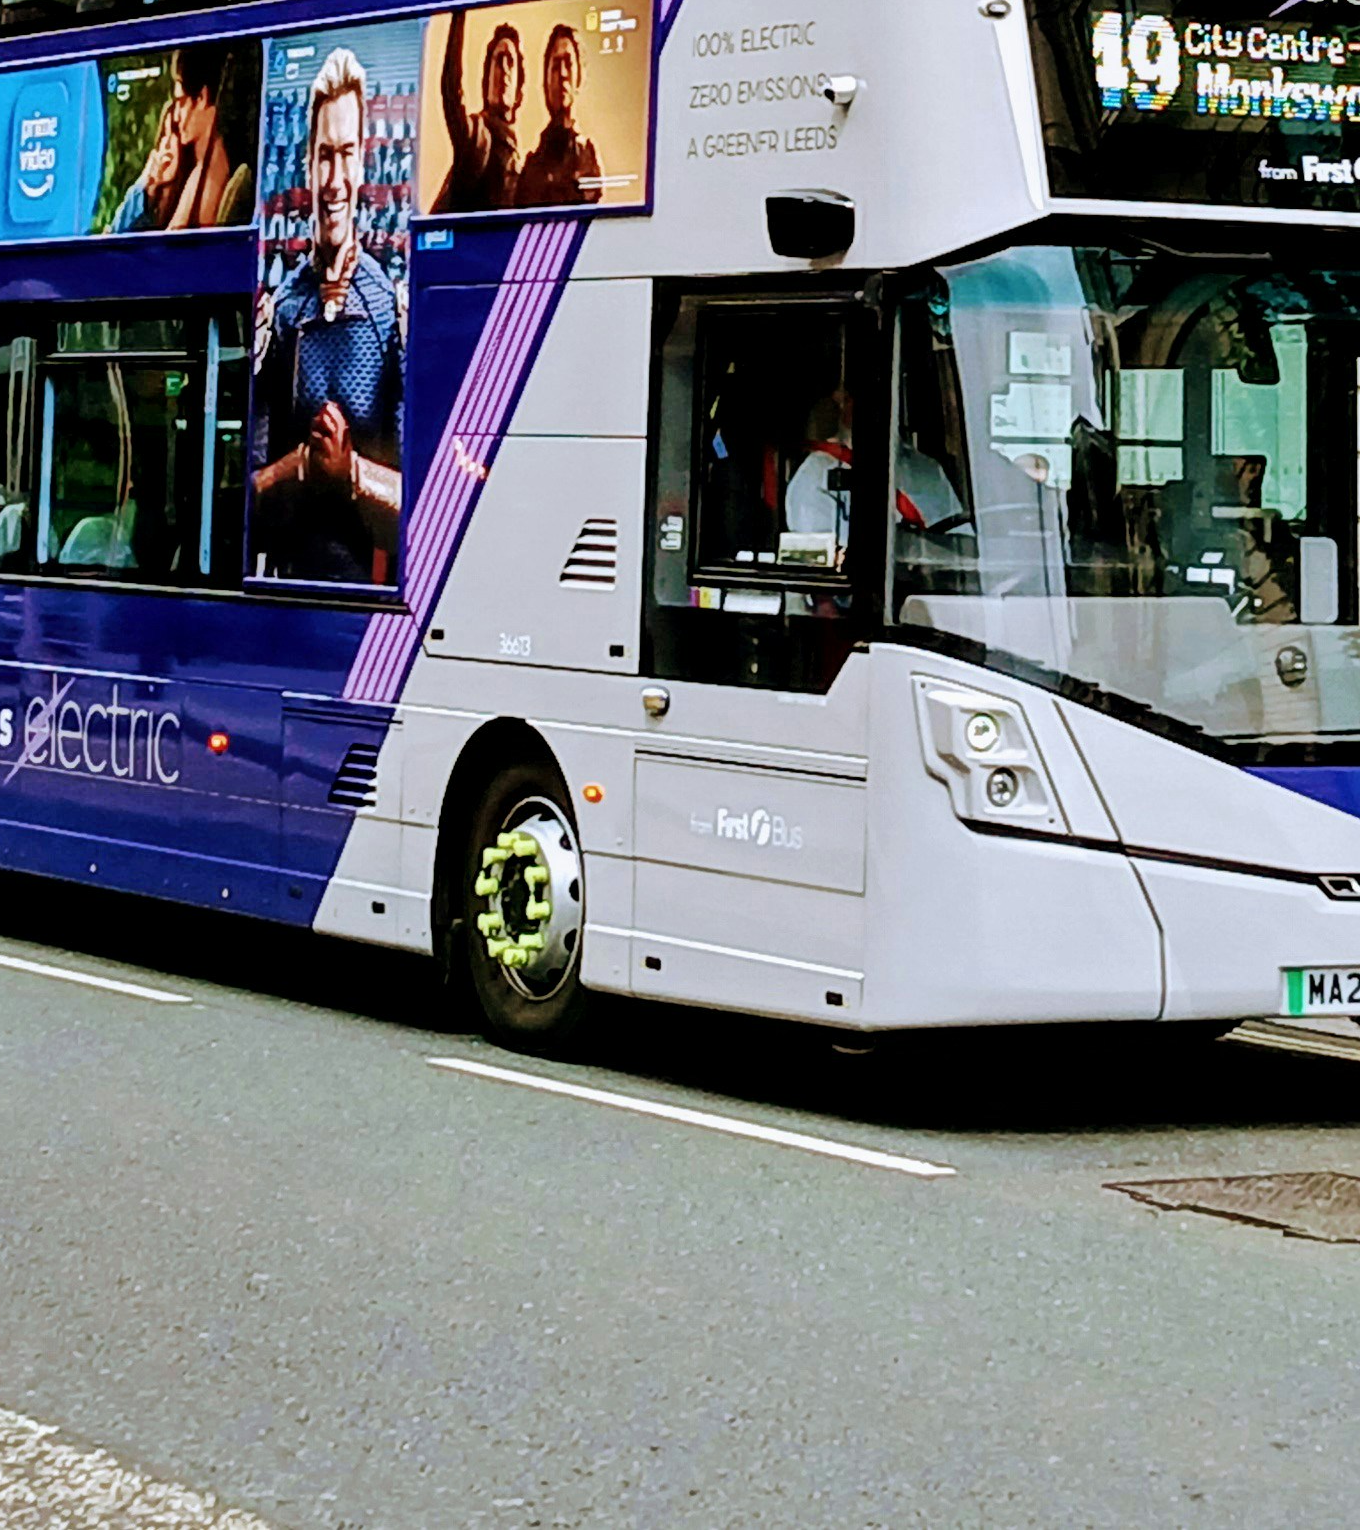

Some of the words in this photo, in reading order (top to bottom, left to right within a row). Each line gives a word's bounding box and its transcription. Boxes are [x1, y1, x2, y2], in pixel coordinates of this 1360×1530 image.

[693, 32, 735, 57] 100%
[741, 21, 816, 52] ELECTRIC
[1184, 22, 1243, 59] City
[1246, 26, 1346, 65] Centre
[1092, 11, 1181, 111] 19
[689, 82, 731, 108] ZERO
[737, 72, 828, 104] EMISSIONS
[20, 111, 58, 147] prime
[687, 137, 699, 159] A
[785, 124, 838, 153] LEEDS
[19, 142, 56, 171] video
[1258, 158, 1298, 181] from
[1302, 155, 1354, 185] First
[24, 673, 180, 783] electric
[772, 816, 803, 850] Bus
